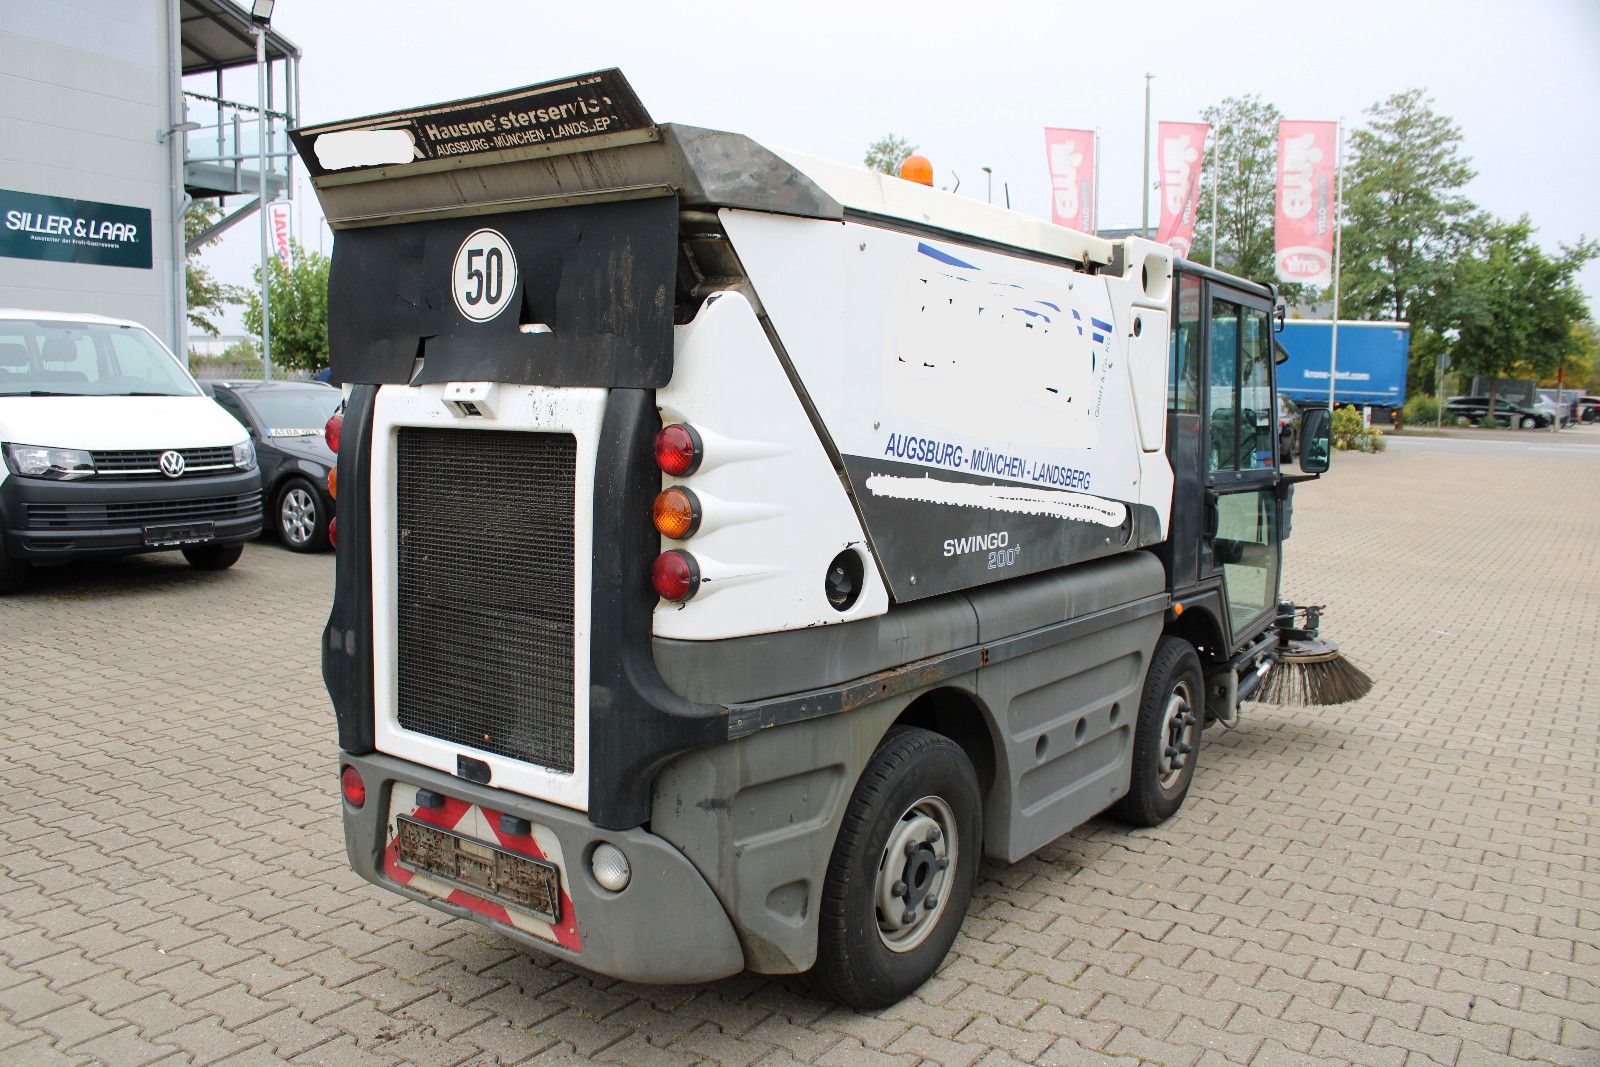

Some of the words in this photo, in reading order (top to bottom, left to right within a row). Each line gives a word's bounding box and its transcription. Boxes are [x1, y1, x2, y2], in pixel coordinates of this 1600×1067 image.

[436, 138, 490, 157] AUGSBURG
[495, 129, 545, 149] MÜNCHEN
[5, 210, 73, 237] SILLER
[74, 218, 87, 238] &
[89, 220, 137, 243] LAAR
[465, 247, 503, 306] 50
[884, 432, 963, 468] AUGSBURG
[970, 447, 1026, 478] MÜNCHEN
[1032, 461, 1091, 490] LANDSBERG
[943, 531, 1009, 557] SWINGO
